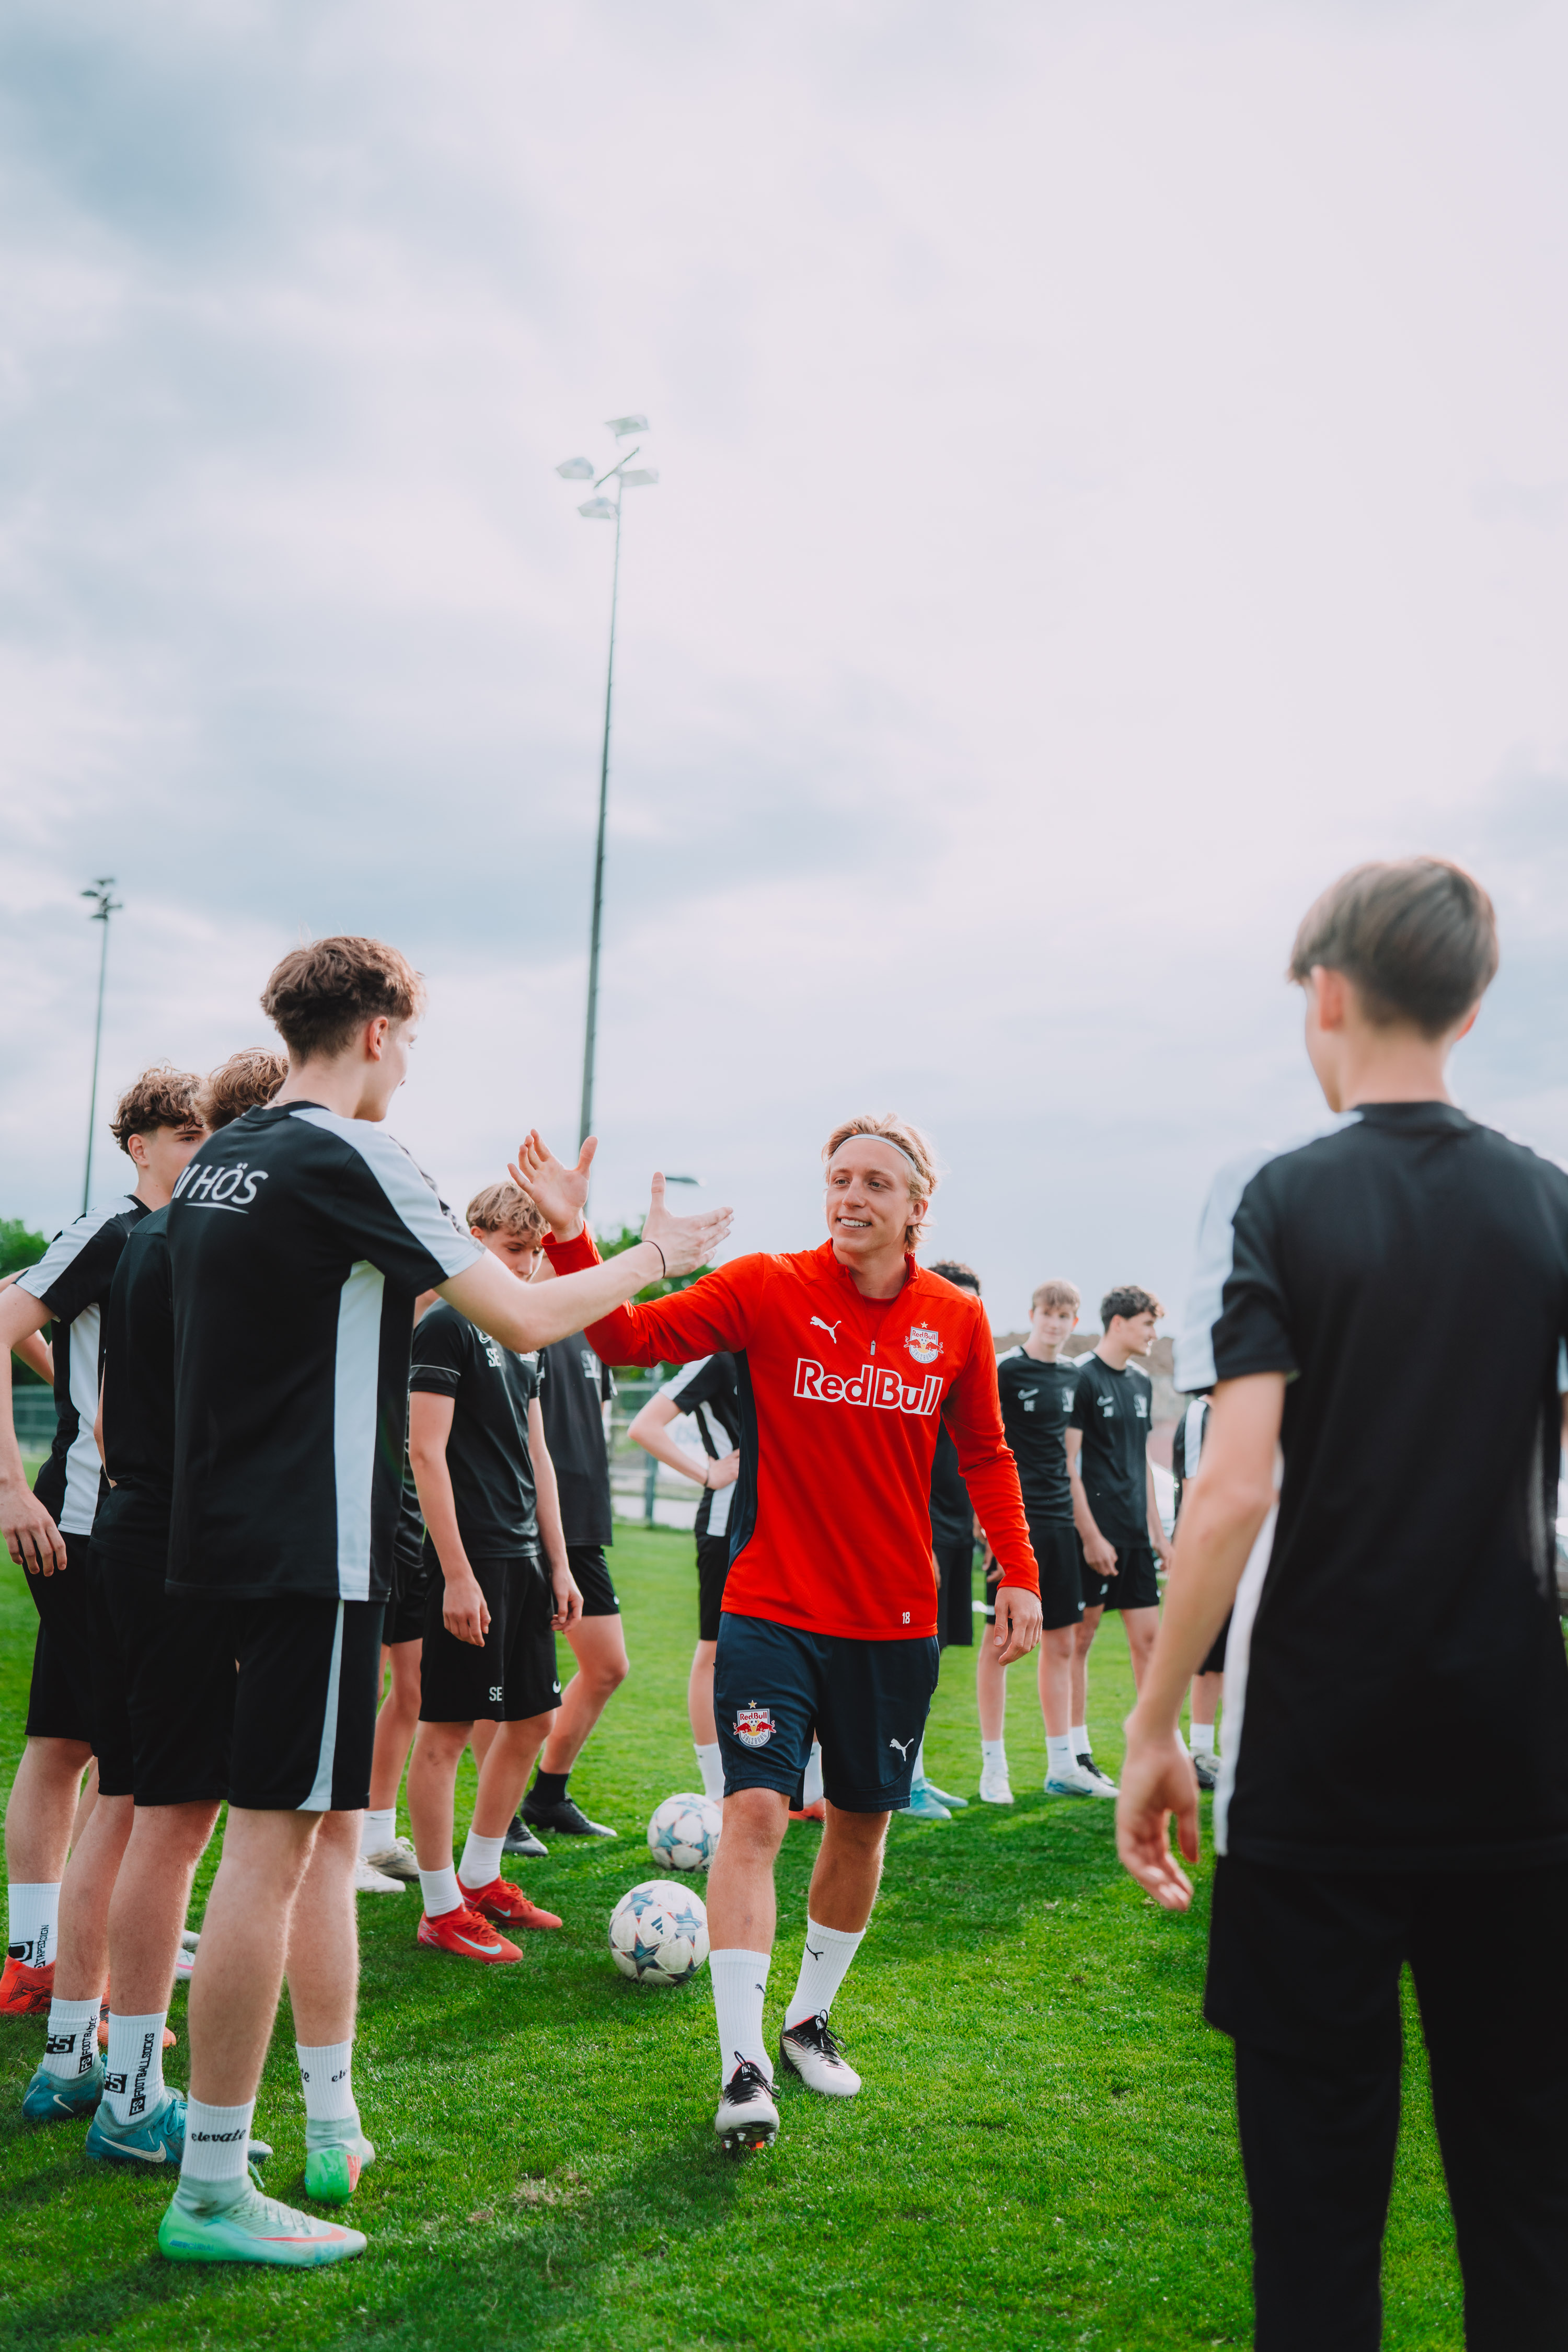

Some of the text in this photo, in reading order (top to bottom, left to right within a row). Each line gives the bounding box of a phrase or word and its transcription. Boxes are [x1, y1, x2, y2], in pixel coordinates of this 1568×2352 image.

[485, 1347, 501, 1367] SE
[912, 1349, 935, 1361] SALZBURG
[794, 1358, 943, 1415] Red Bull
[902, 1611, 910, 1624] 18
[489, 1686, 502, 1701] SE
[742, 1733, 767, 1744] SALZBURG
[79, 2055, 92, 2072] FS
[134, 2033, 155, 2097] FOOTBALLSOCKS
[131, 2097, 144, 2114] FS
[191, 2128, 246, 2142] elevate
